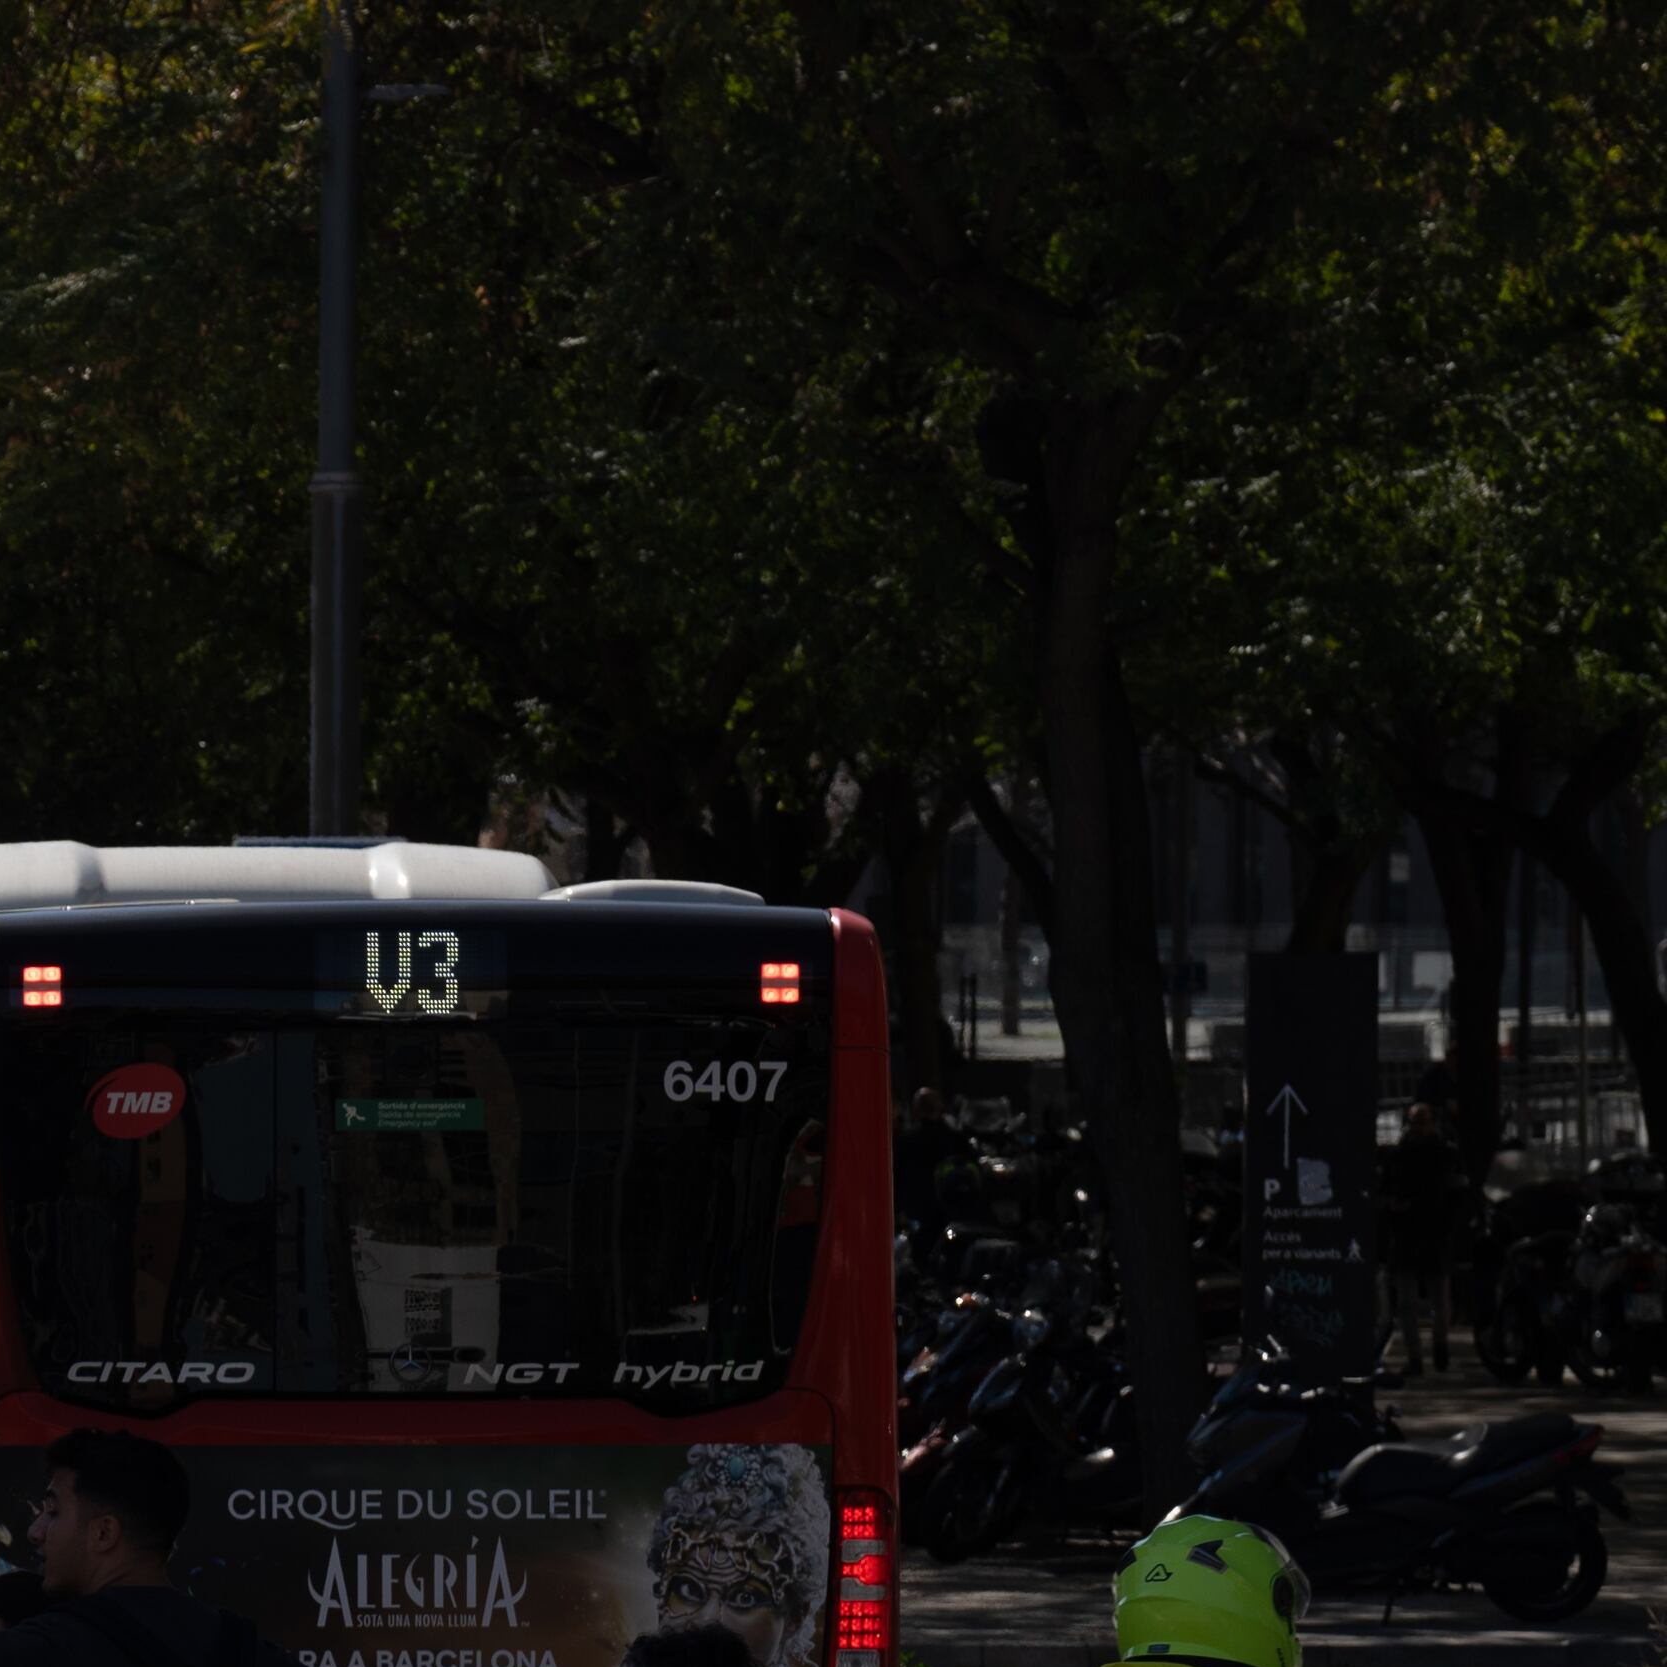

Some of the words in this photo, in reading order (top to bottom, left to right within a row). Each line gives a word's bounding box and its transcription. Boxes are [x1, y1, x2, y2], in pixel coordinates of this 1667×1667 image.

[366, 931, 459, 1014] V3
[663, 1060, 788, 1102] 6407
[106, 1091, 173, 1114] TMB
[1264, 1178, 1282, 1201] P
[1262, 1205, 1343, 1220] Aparcament
[67, 1361, 255, 1384] CITARO
[463, 1362, 580, 1384] NGT
[613, 1360, 766, 1390] hybrid
[227, 1488, 383, 1530] CIRQUE
[397, 1488, 452, 1519] DU
[357, 1613, 384, 1628] SOTA
[387, 1613, 411, 1628] UNA
[414, 1613, 444, 1628] NOVA
[447, 1613, 477, 1628] LLUM
